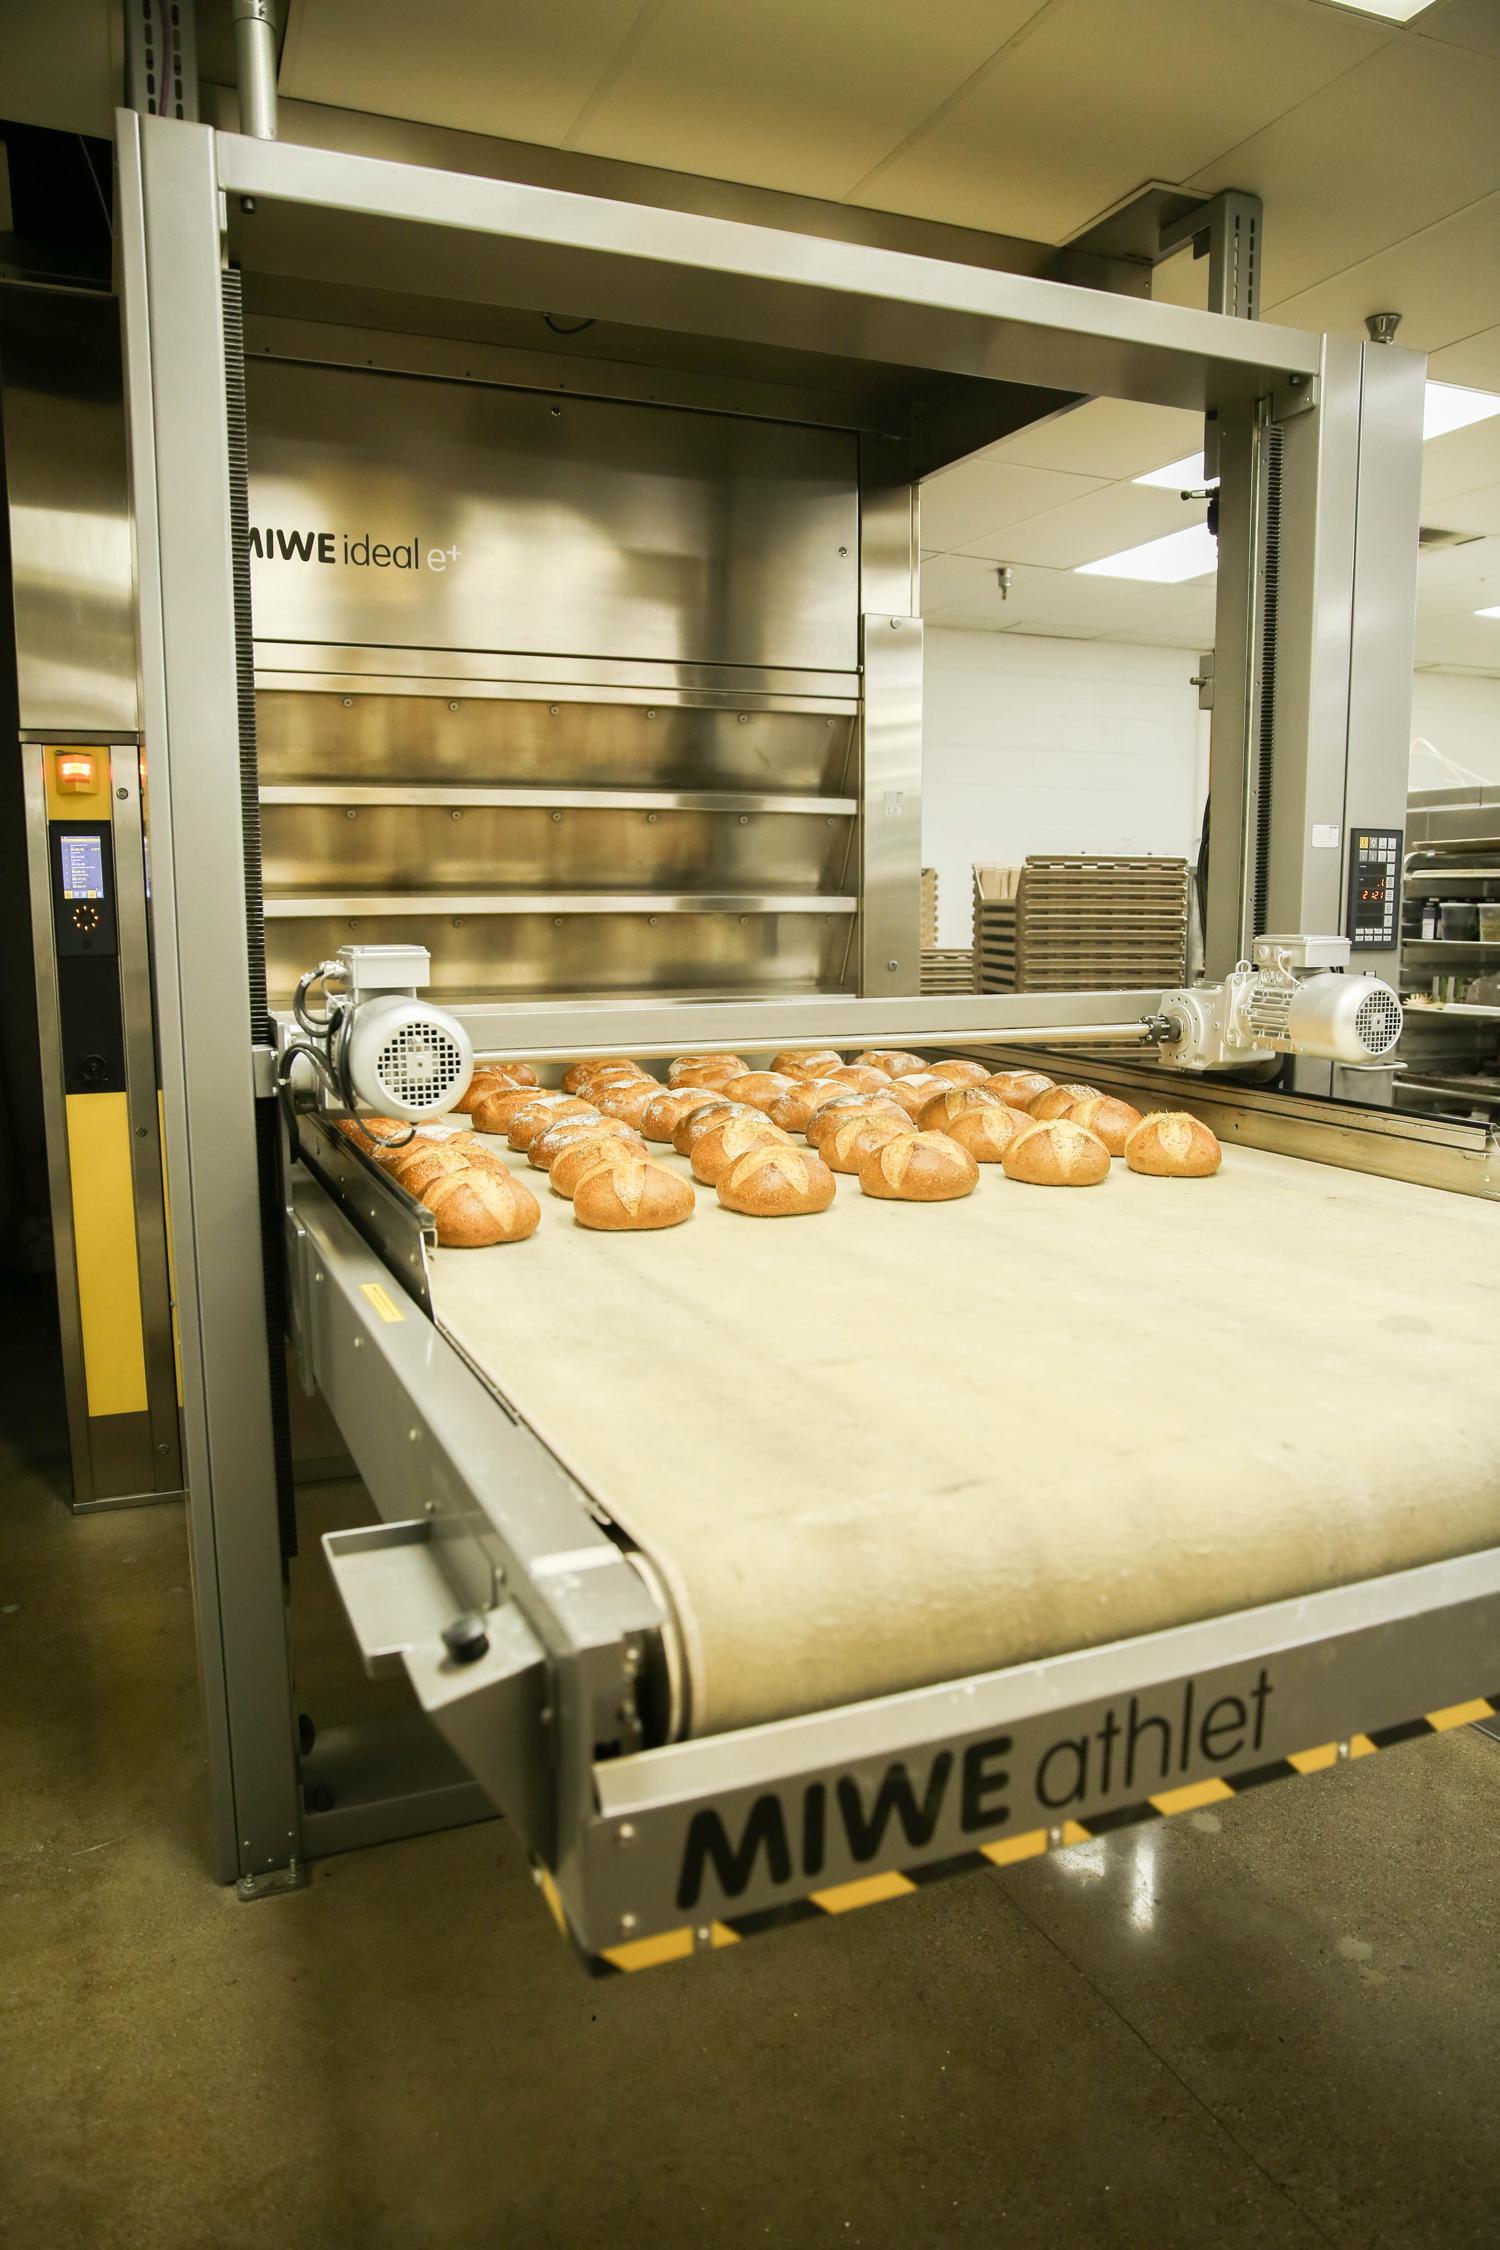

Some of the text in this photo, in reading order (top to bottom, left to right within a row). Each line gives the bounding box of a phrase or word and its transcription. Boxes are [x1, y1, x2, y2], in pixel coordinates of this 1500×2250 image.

[343, 534, 419, 570] ideal
[426, 544, 462, 572] e+
[676, 1669, 1273, 1910] MIWE athlet
